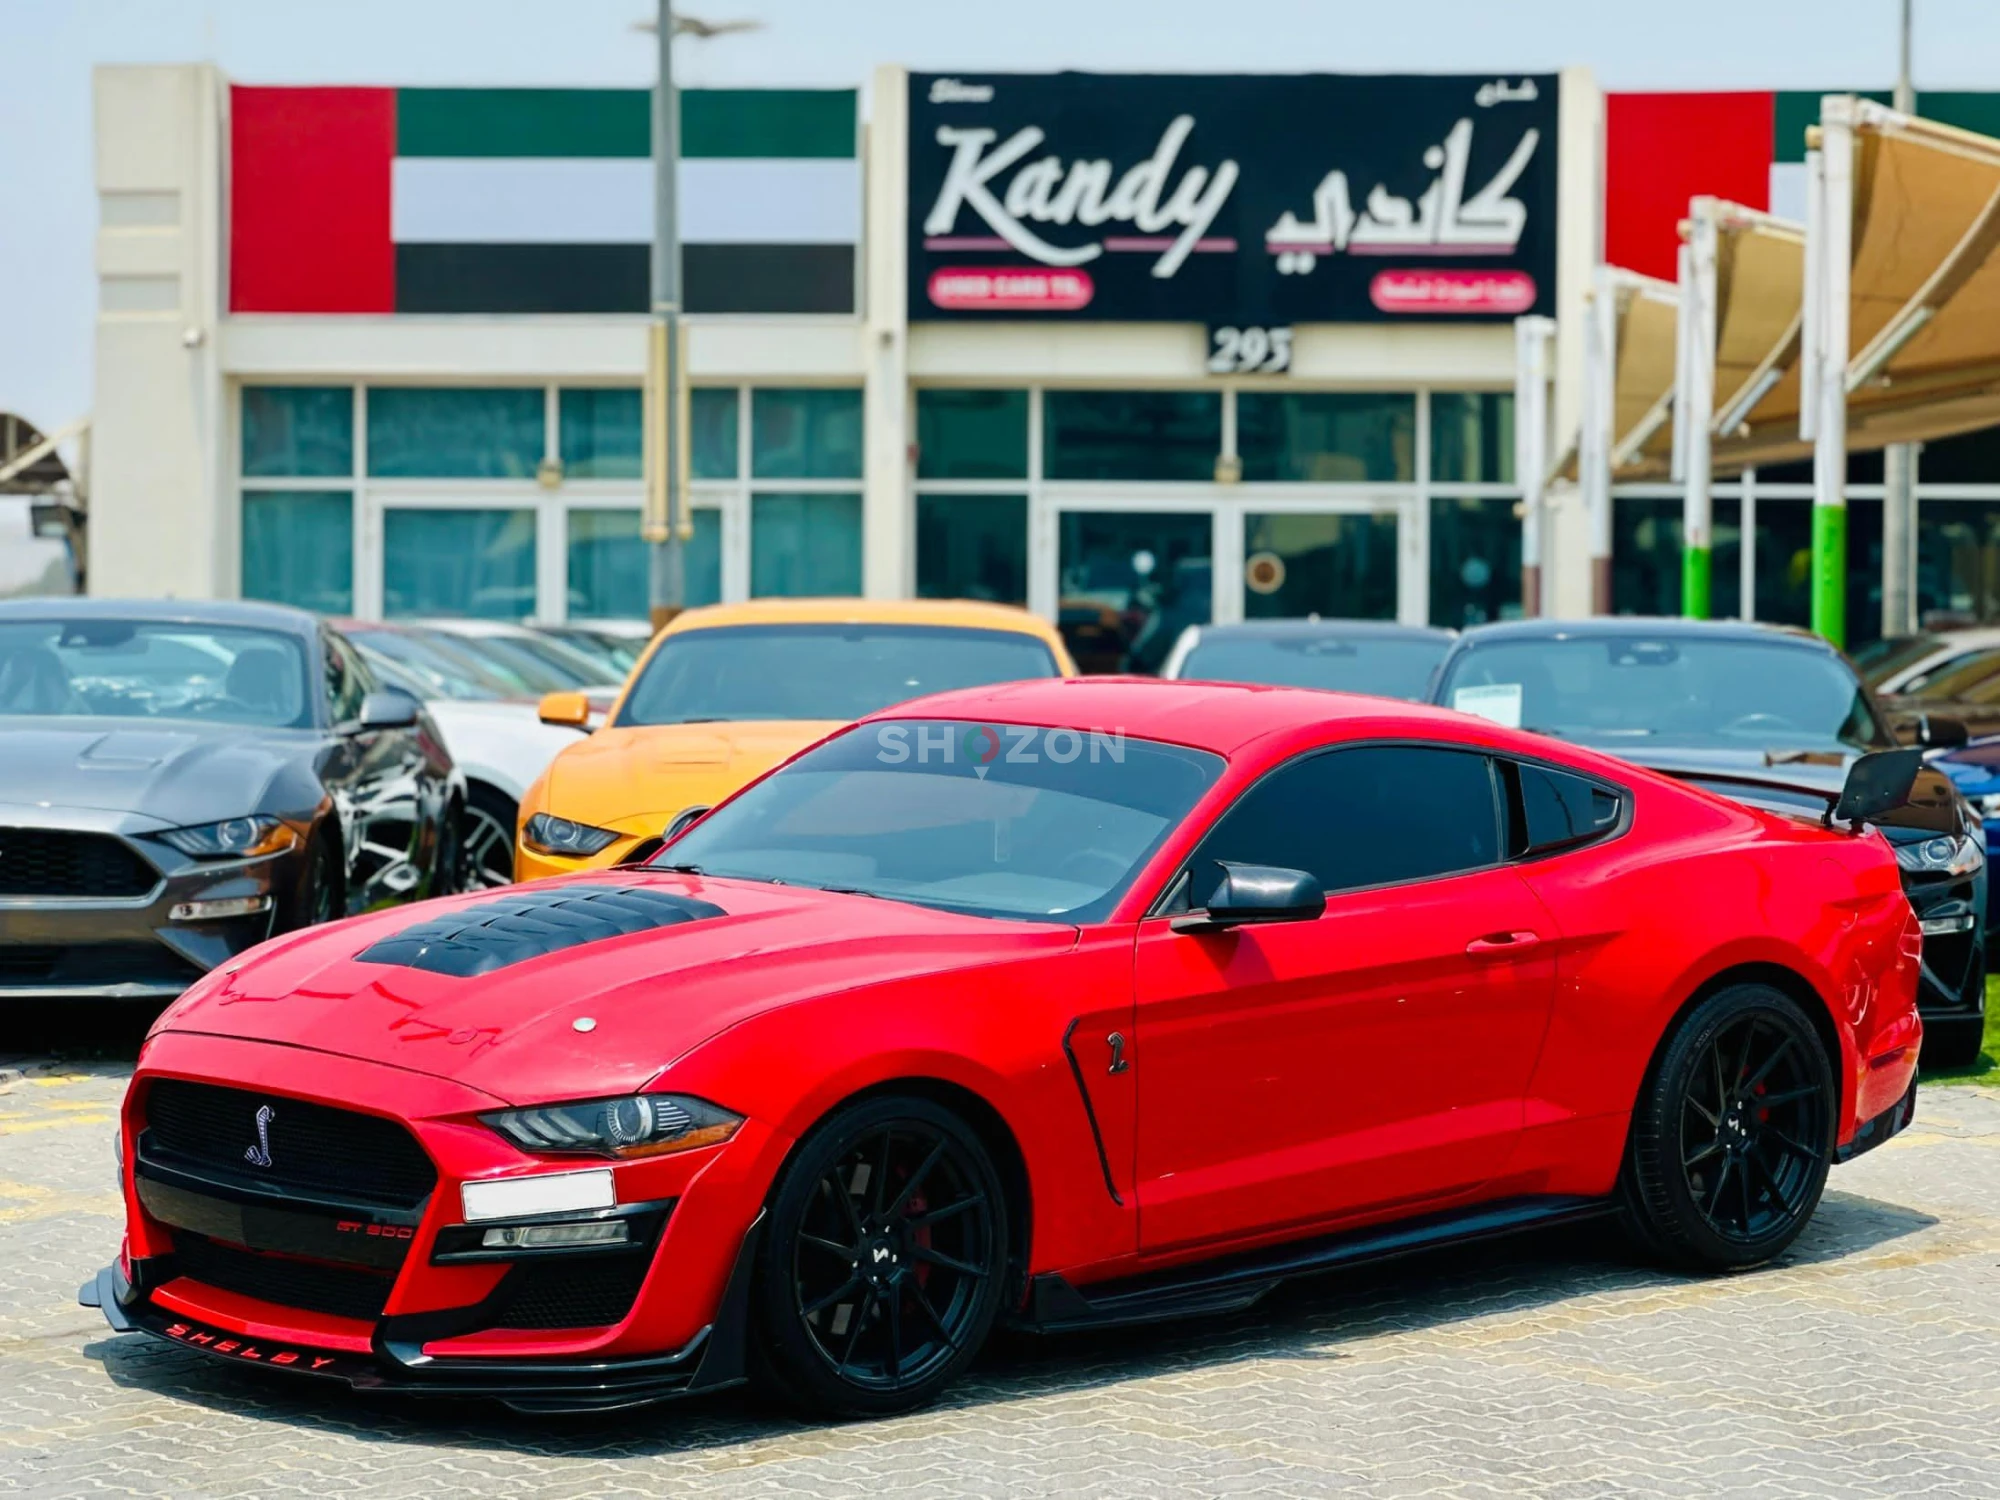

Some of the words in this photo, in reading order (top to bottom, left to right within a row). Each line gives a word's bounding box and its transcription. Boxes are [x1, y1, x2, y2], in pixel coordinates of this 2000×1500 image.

[923, 114, 1240, 278] Kandy
[1265, 117, 1540, 275] كاندي
[1208, 325, 1294, 372] 295
[336, 1220, 361, 1233] GT
[165, 1324, 336, 1368] SHELBY
